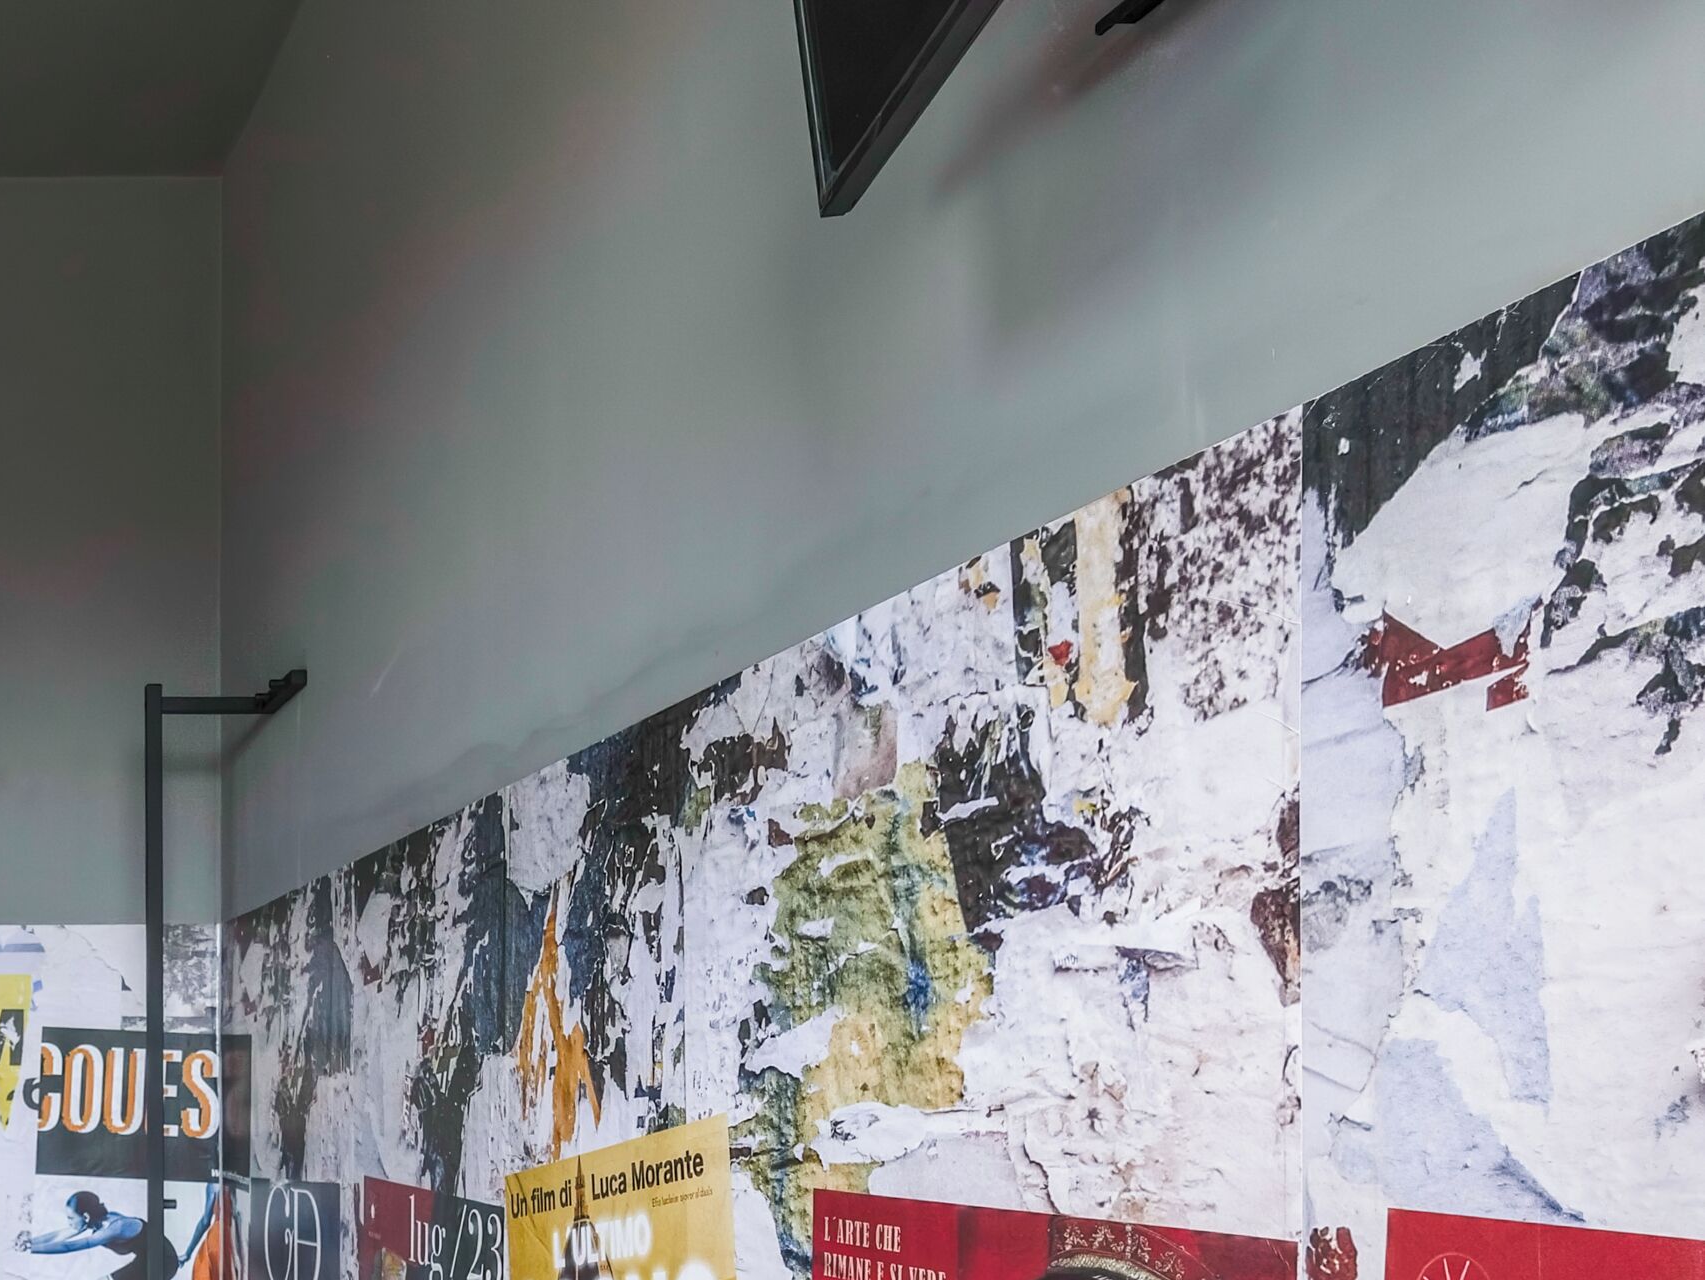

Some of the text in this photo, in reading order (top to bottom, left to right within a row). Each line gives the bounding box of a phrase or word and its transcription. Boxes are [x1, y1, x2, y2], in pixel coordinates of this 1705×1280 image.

[510, 1193, 528, 1218] Un
[531, 1183, 556, 1213] film
[559, 1178, 572, 1207] di
[591, 1171, 626, 1200] Luca
[631, 1150, 704, 1192] Morante
[875, 1224, 901, 1252] CHE
